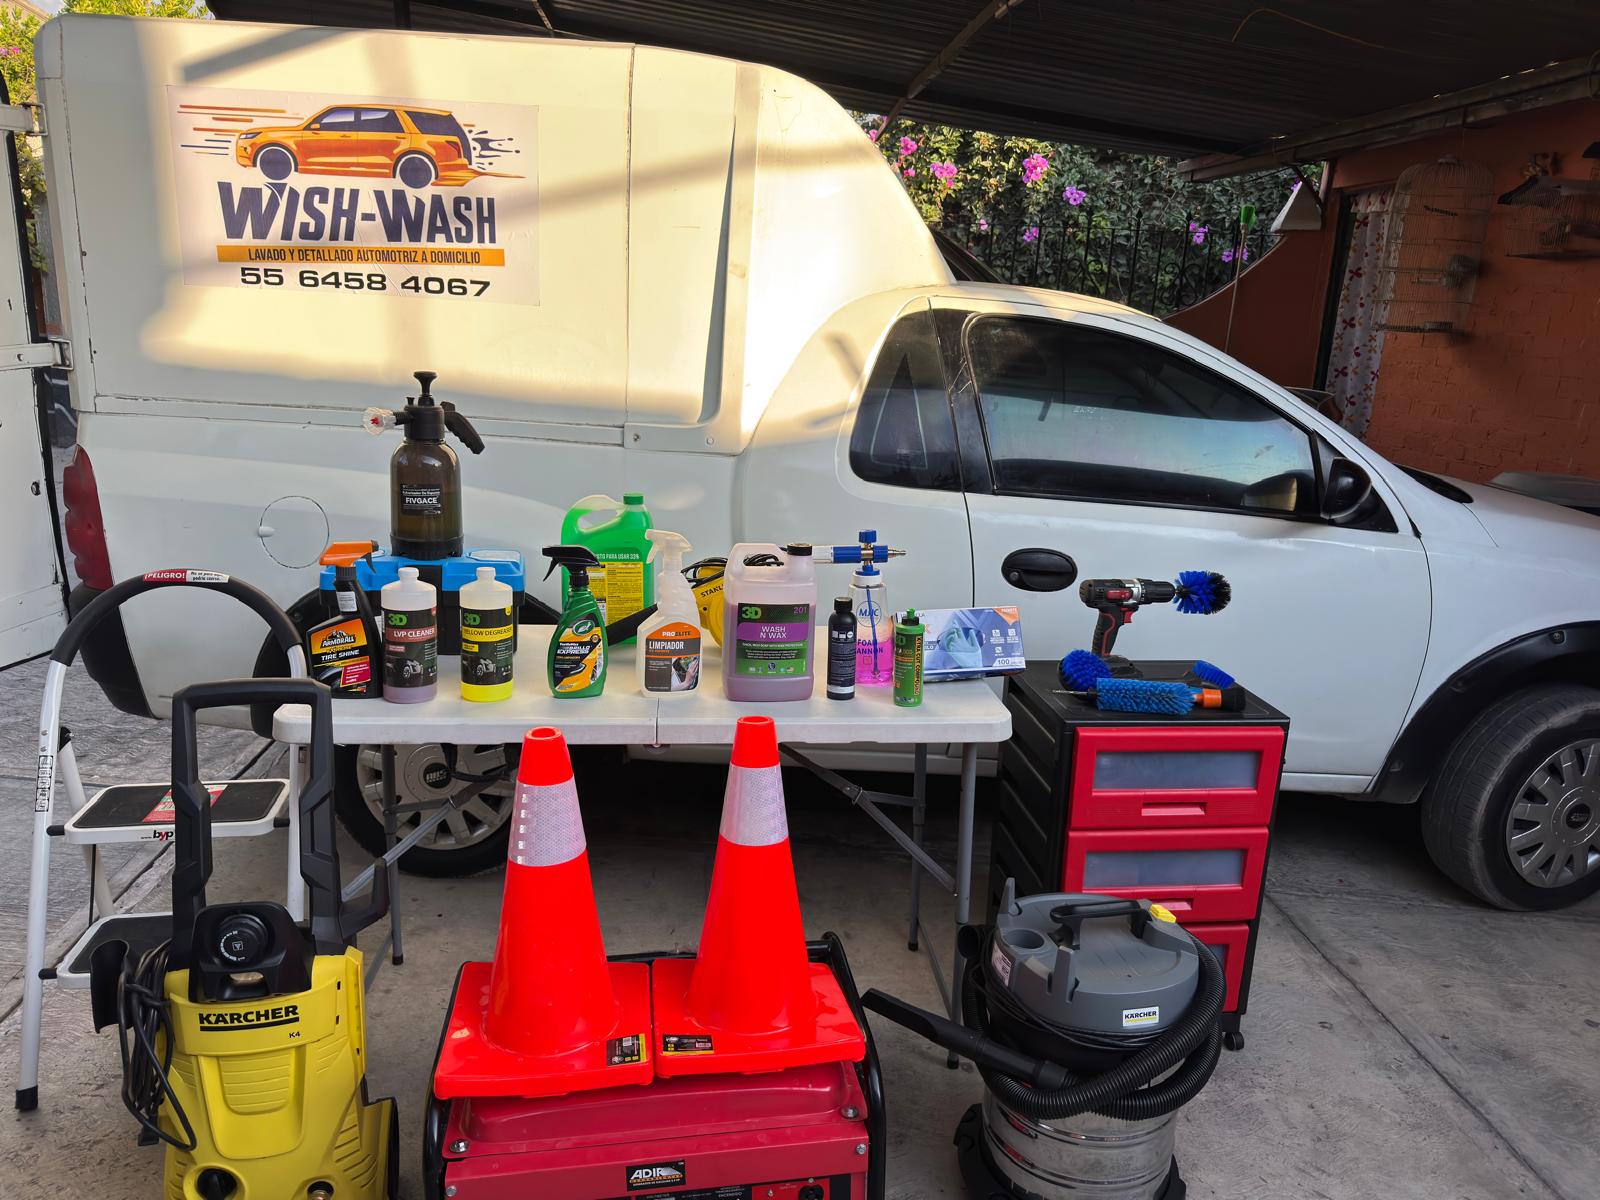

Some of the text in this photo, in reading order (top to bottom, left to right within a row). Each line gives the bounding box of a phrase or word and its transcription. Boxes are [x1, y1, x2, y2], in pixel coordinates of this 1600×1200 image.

[217, 181, 496, 244] WISH-WASH
[248, 248, 481, 264] LAVADO Y DETALLADO AUTOMOTRIZ A DOMICILIO
[240, 267, 491, 297] 55 6458 4067
[701, 584, 724, 598] STANL
[388, 613, 408, 626] 3D
[463, 612, 481, 626] 3D
[742, 606, 762, 620] 3D
[393, 630, 407, 638] LVP
[648, 640, 685, 650] LIMPIADOR
[321, 652, 337, 661] TIRE
[338, 649, 360, 659] SHINE
[153, 829, 174, 842] byp
[198, 1004, 299, 1025] KÄRCHER
